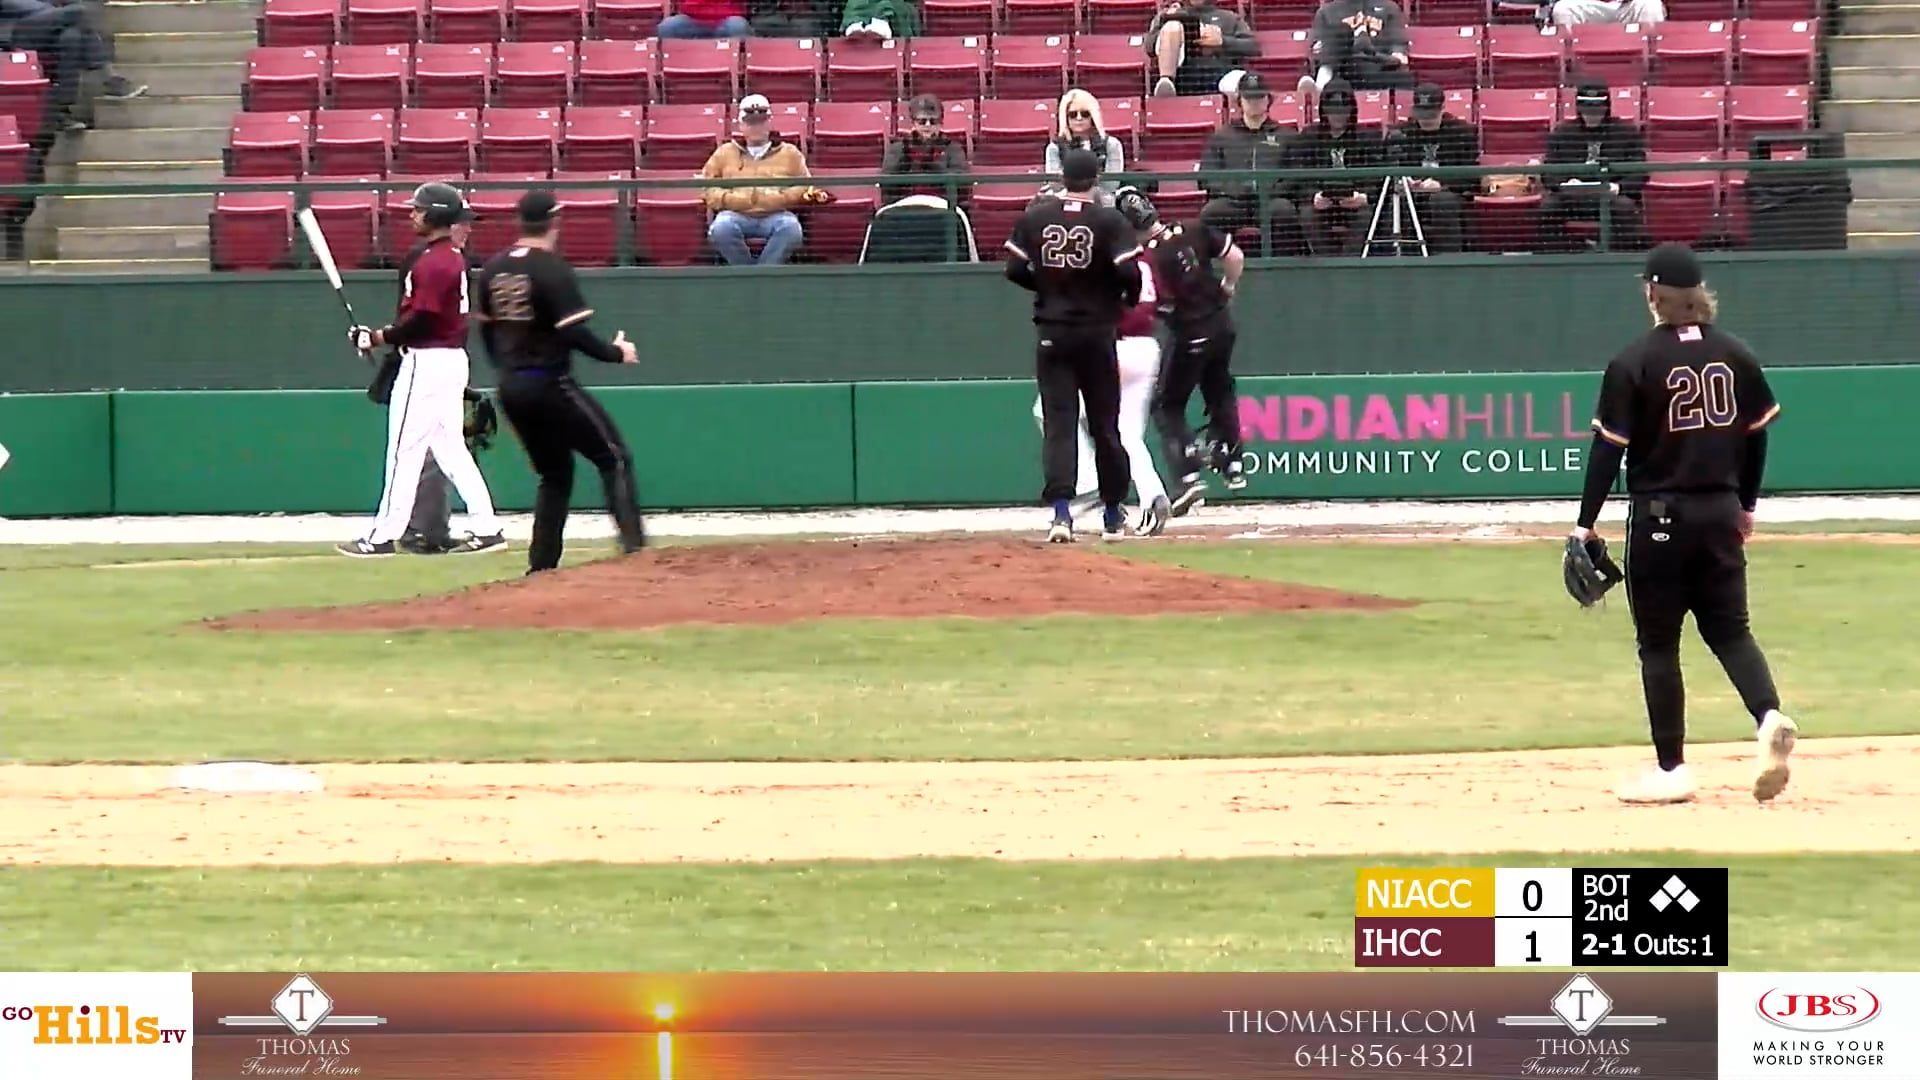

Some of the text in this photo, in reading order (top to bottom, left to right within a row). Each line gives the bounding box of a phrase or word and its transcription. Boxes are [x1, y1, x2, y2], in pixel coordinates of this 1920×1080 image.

[1041, 224, 1094, 269] 23
[1666, 362, 1738, 432] 20
[1241, 448, 1582, 475] OMMUNITY COLLE
